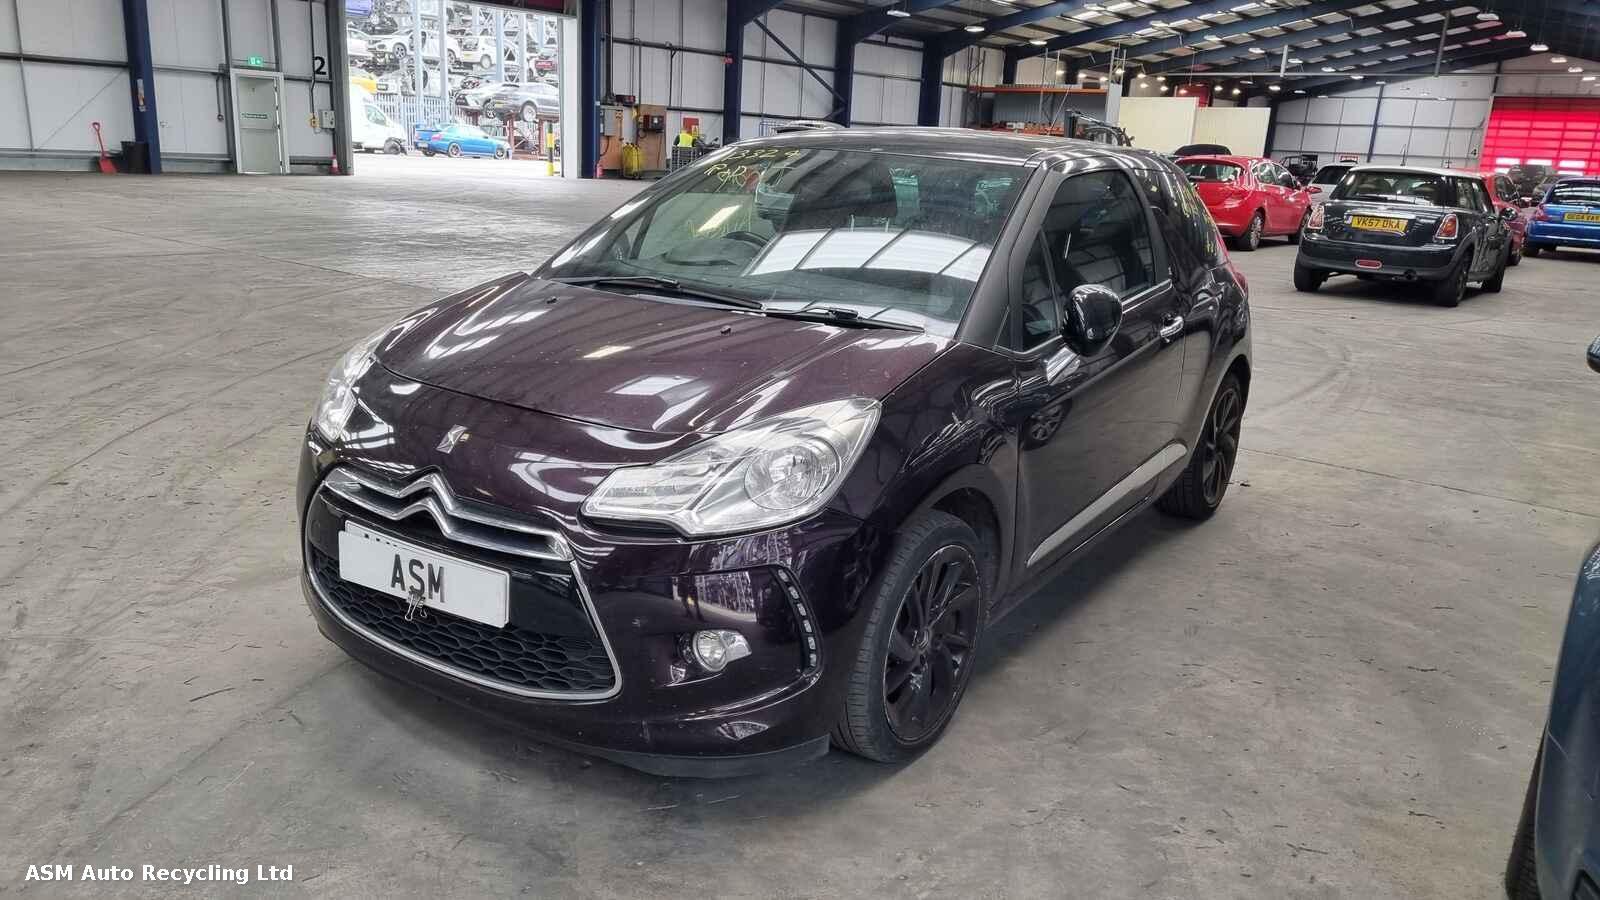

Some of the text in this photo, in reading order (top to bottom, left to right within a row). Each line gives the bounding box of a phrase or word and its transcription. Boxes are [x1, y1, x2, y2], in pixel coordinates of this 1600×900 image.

[313, 56, 326, 75] 2
[1357, 216, 1380, 227] VK57
[391, 553, 446, 603] ASM
